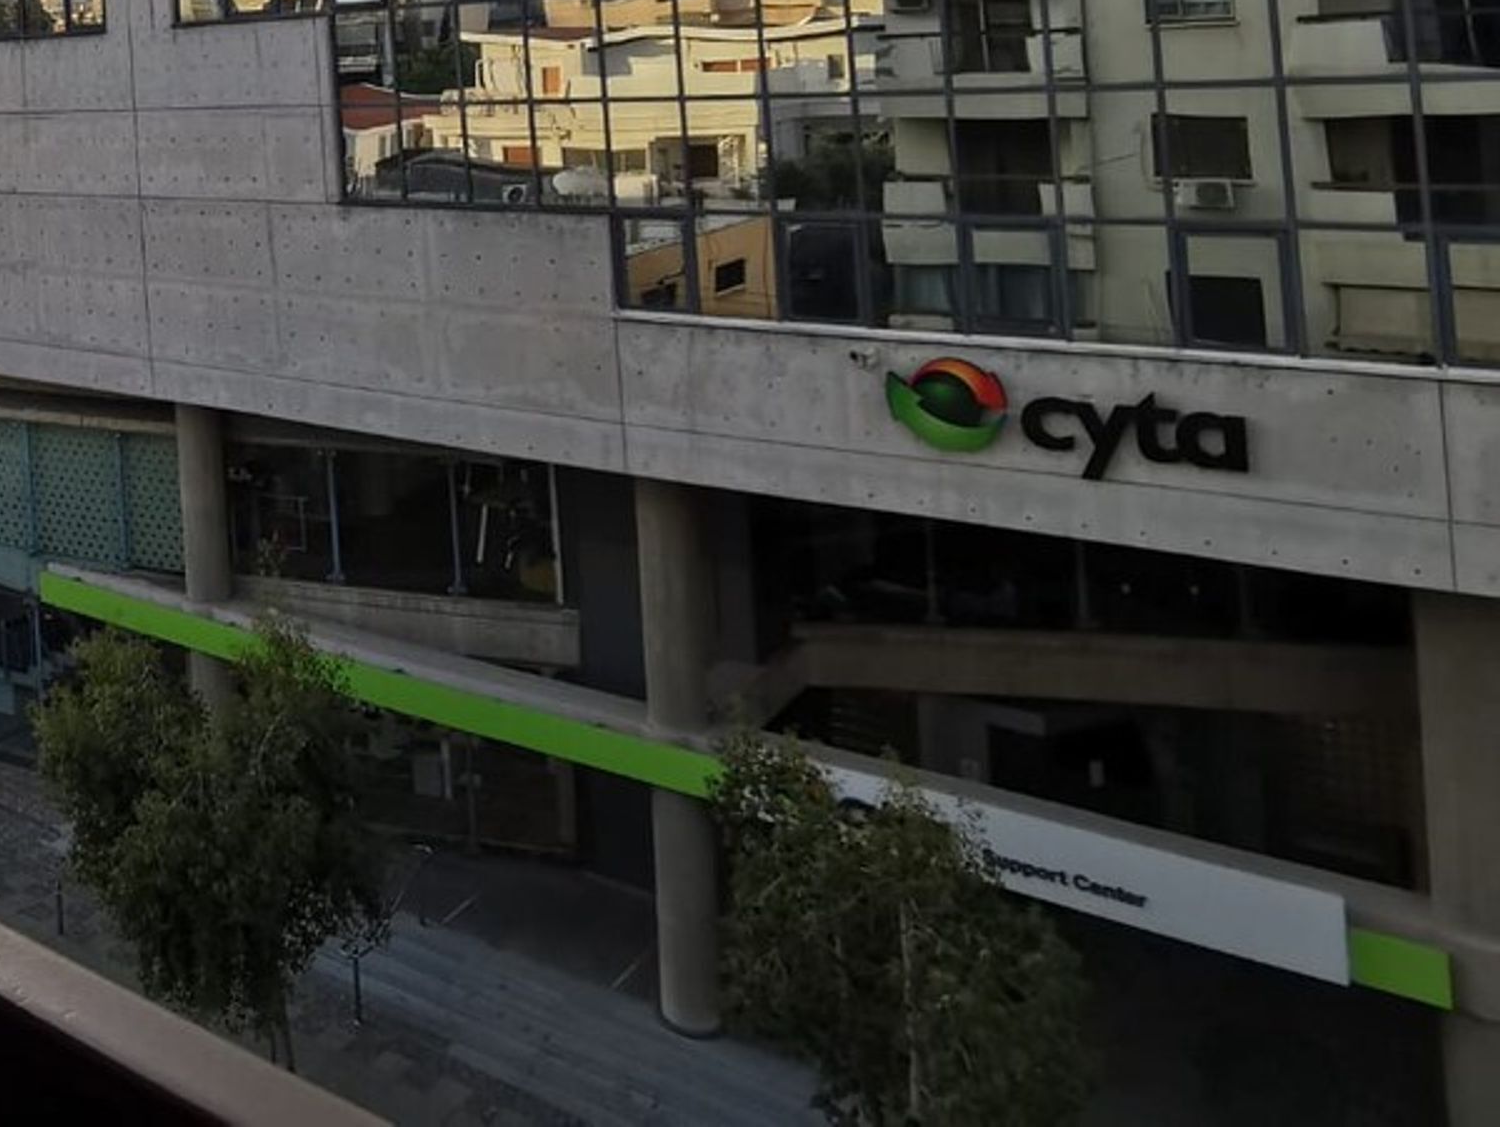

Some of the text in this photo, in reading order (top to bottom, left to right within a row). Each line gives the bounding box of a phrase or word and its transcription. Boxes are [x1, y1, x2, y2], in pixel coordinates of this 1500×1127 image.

[1021, 392, 1250, 480] cyta
[982, 848, 1147, 908] Support Center
